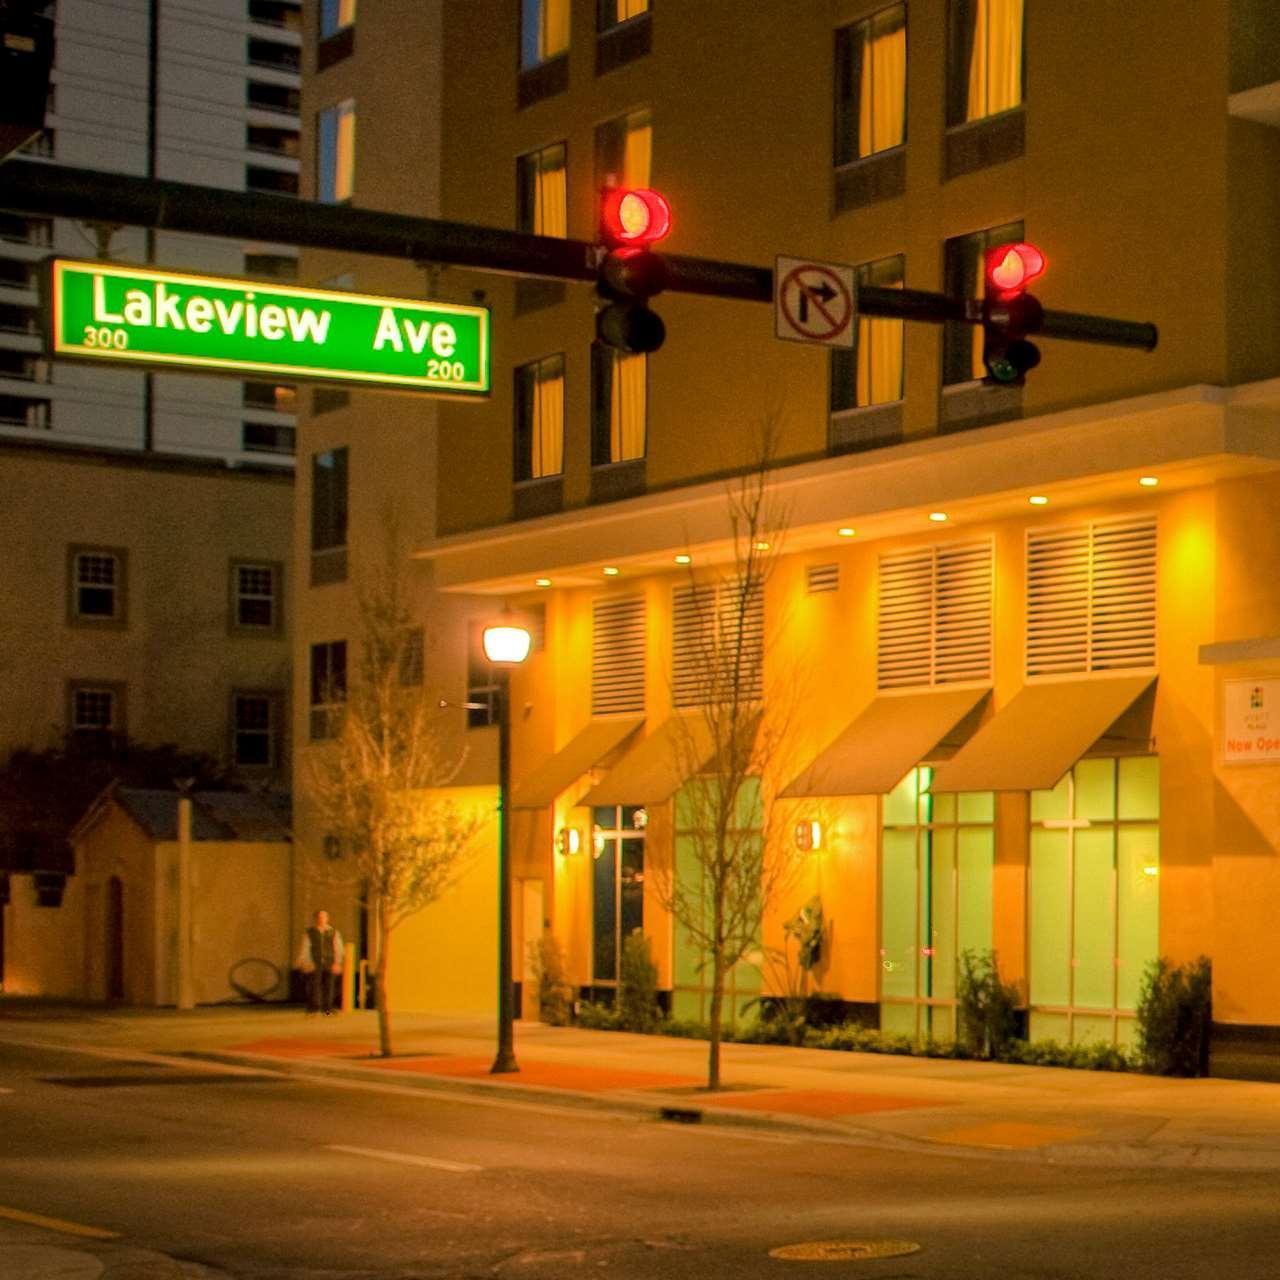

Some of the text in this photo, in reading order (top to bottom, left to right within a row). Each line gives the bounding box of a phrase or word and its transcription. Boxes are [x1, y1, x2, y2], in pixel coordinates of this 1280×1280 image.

[93, 273, 457, 358] Lakeview Ave
[83, 325, 128, 349] 300
[427, 358, 465, 381] 200
[1227, 740, 1252, 752] Now
